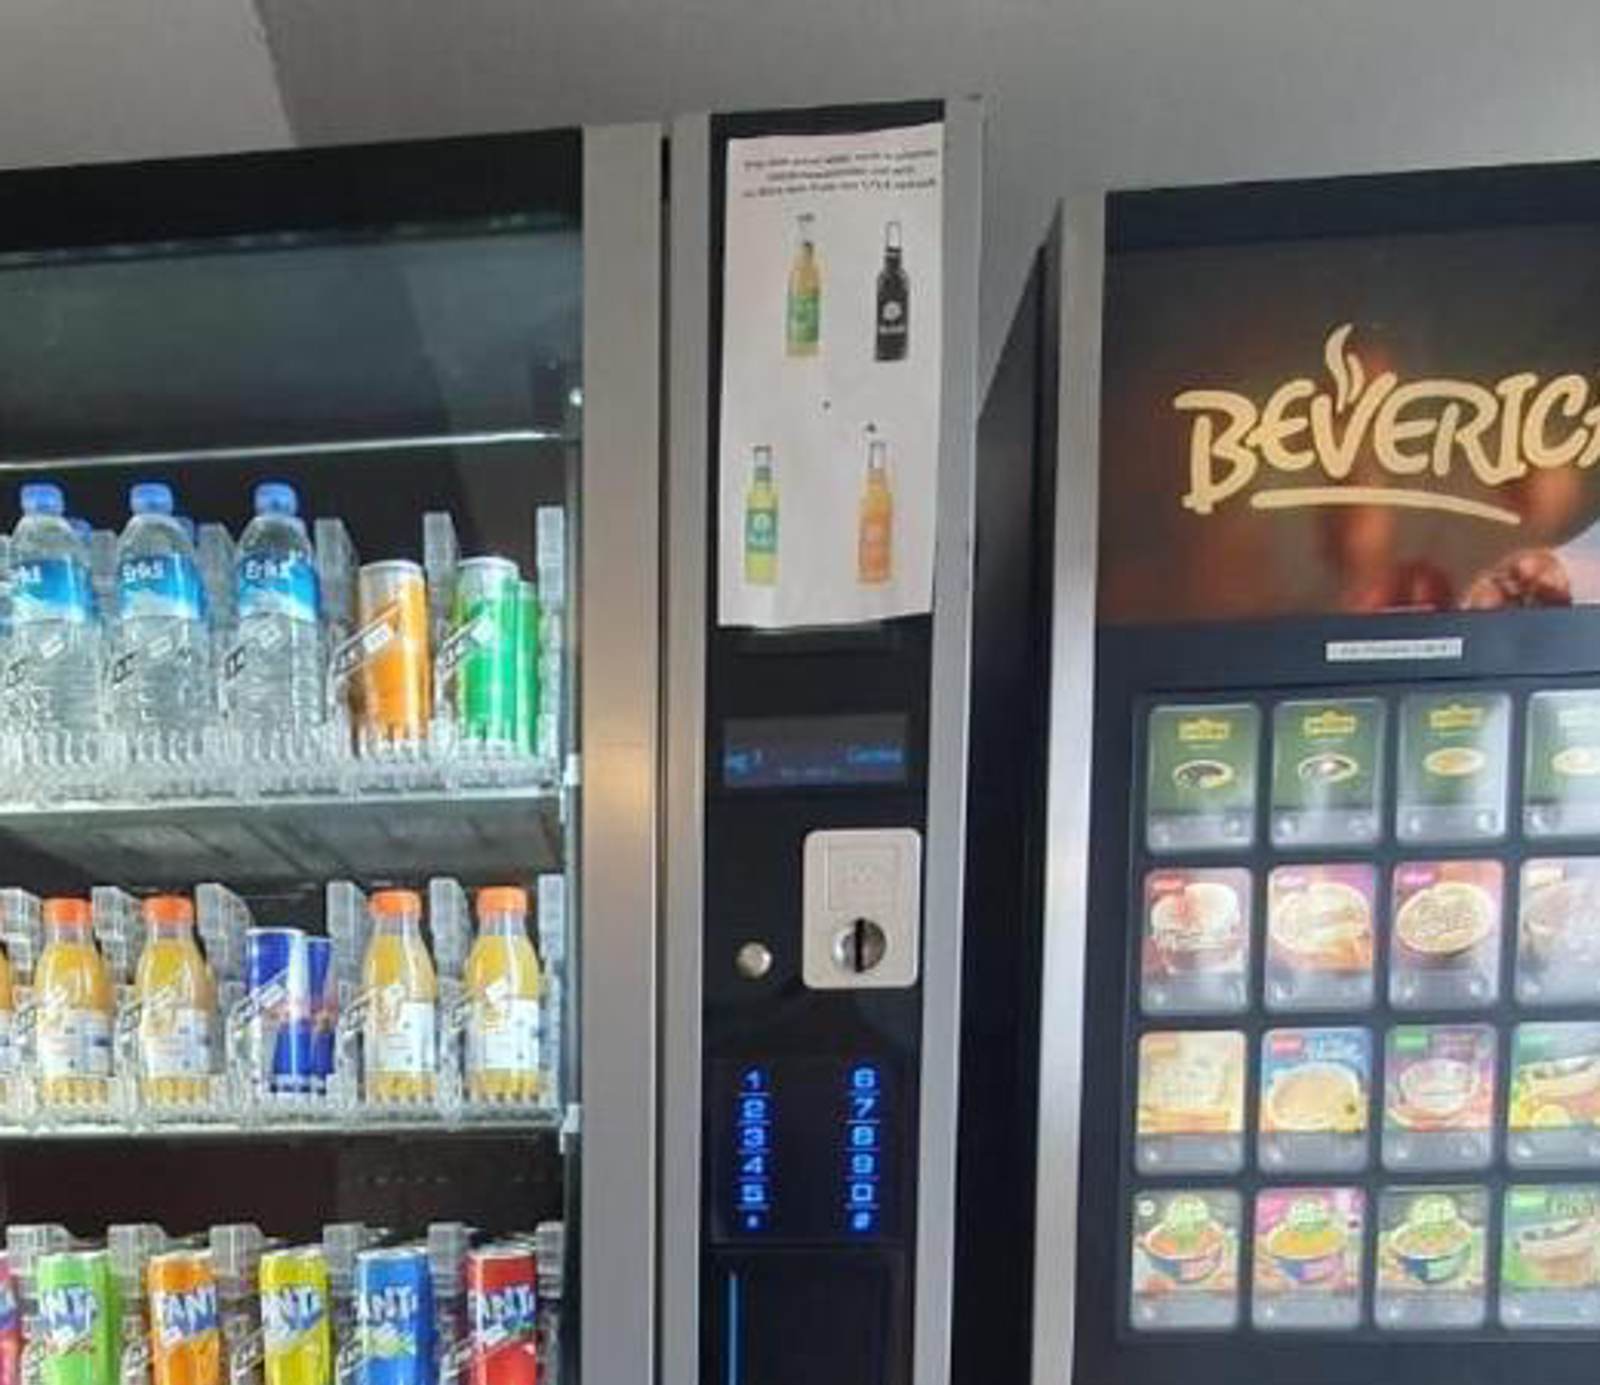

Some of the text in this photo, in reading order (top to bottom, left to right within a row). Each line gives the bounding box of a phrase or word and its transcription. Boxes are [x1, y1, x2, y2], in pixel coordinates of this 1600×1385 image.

[742, 1098, 765, 1119] 2
[854, 1097, 876, 1118] 7
[743, 1126, 765, 1147] 3
[742, 1156, 764, 1174] 4
